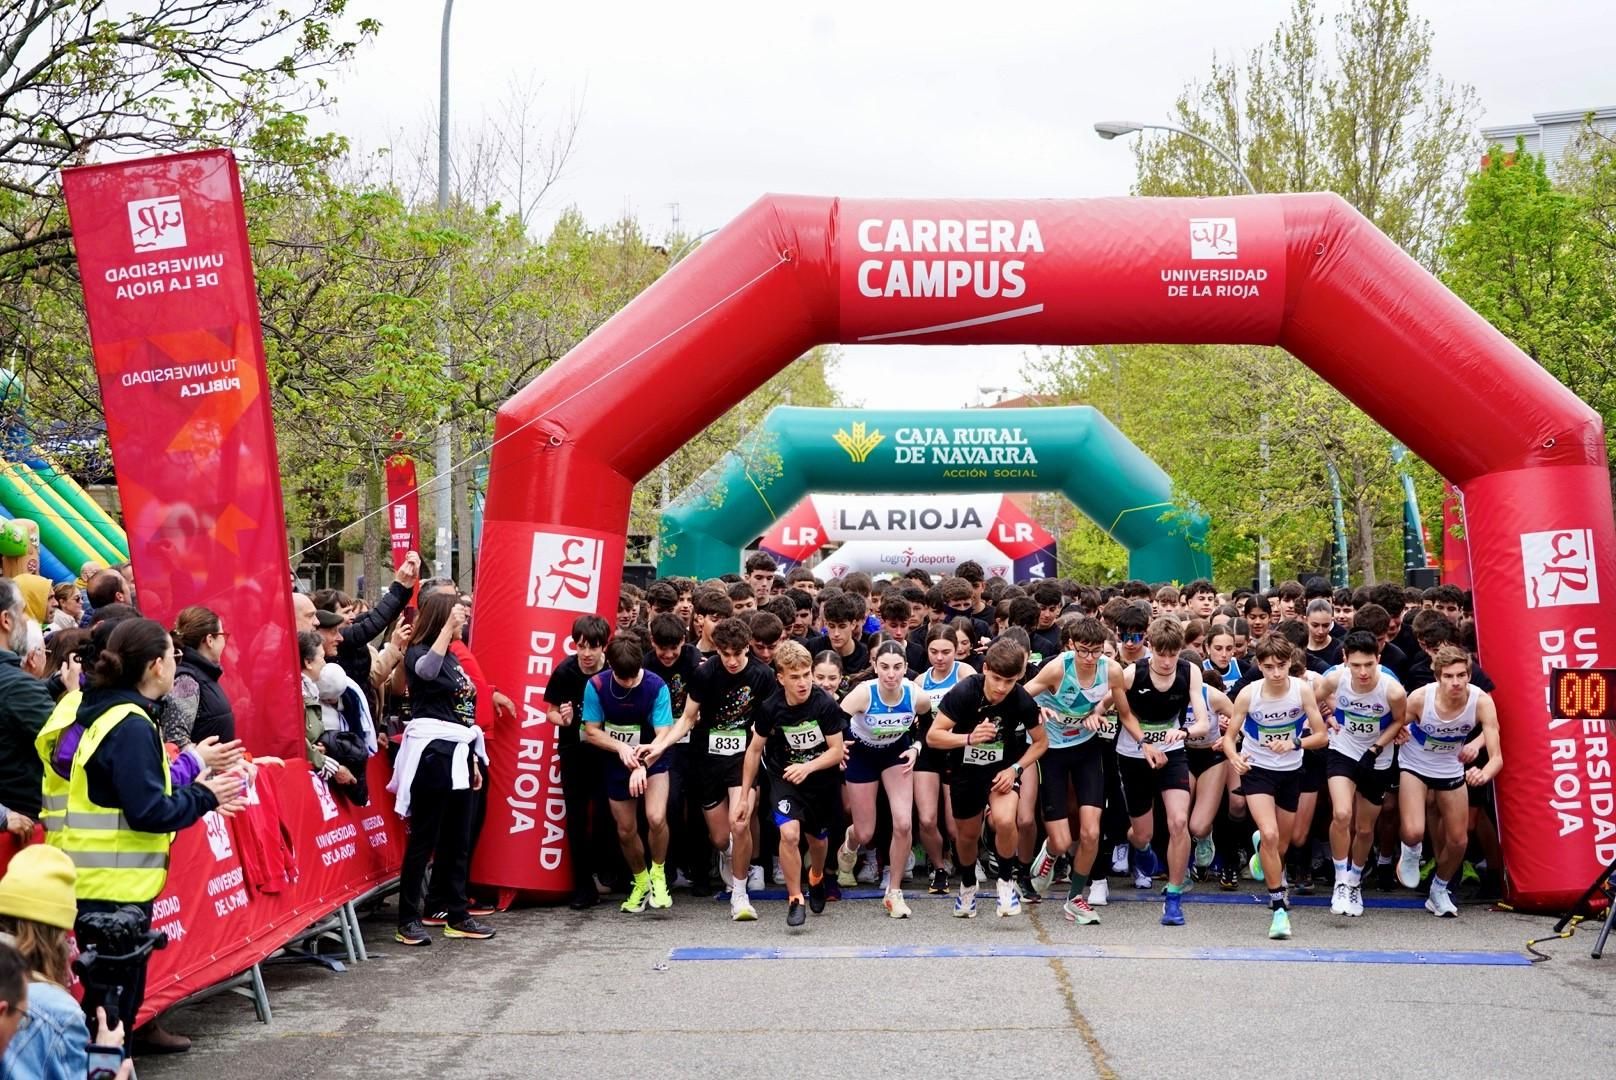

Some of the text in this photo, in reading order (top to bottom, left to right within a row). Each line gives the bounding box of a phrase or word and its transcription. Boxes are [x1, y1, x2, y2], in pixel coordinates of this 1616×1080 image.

[858, 219, 1044, 252] CARRERA
[858, 260, 1026, 298] CAMPUS
[1161, 269, 1268, 281] UNIVERSIDAD
[1168, 285, 1259, 299] DE LA RIOJA
[895, 428, 1028, 446] CAJA RURAL
[895, 447, 1038, 464] DE NAVARRA
[943, 468, 1037, 478] ACCIÓN SOCIAL
[840, 509, 881, 531] LA
[888, 507, 983, 531] RIOJA
[782, 526, 818, 546] LR
[998, 522, 1034, 543] LR
[1560, 672, 1606, 717] 00
[1063, 716, 1084, 725] 87
[1264, 711, 1287, 719] KIA
[506, 630, 556, 834] DE LA RIOJA
[1349, 721, 1374, 733] 343
[715, 737, 740, 750] 833
[791, 730, 817, 745] 375
[970, 748, 996, 762] 526
[1573, 627, 1616, 867] UNERSIDAD
[1549, 738, 1584, 837] RIOJA
